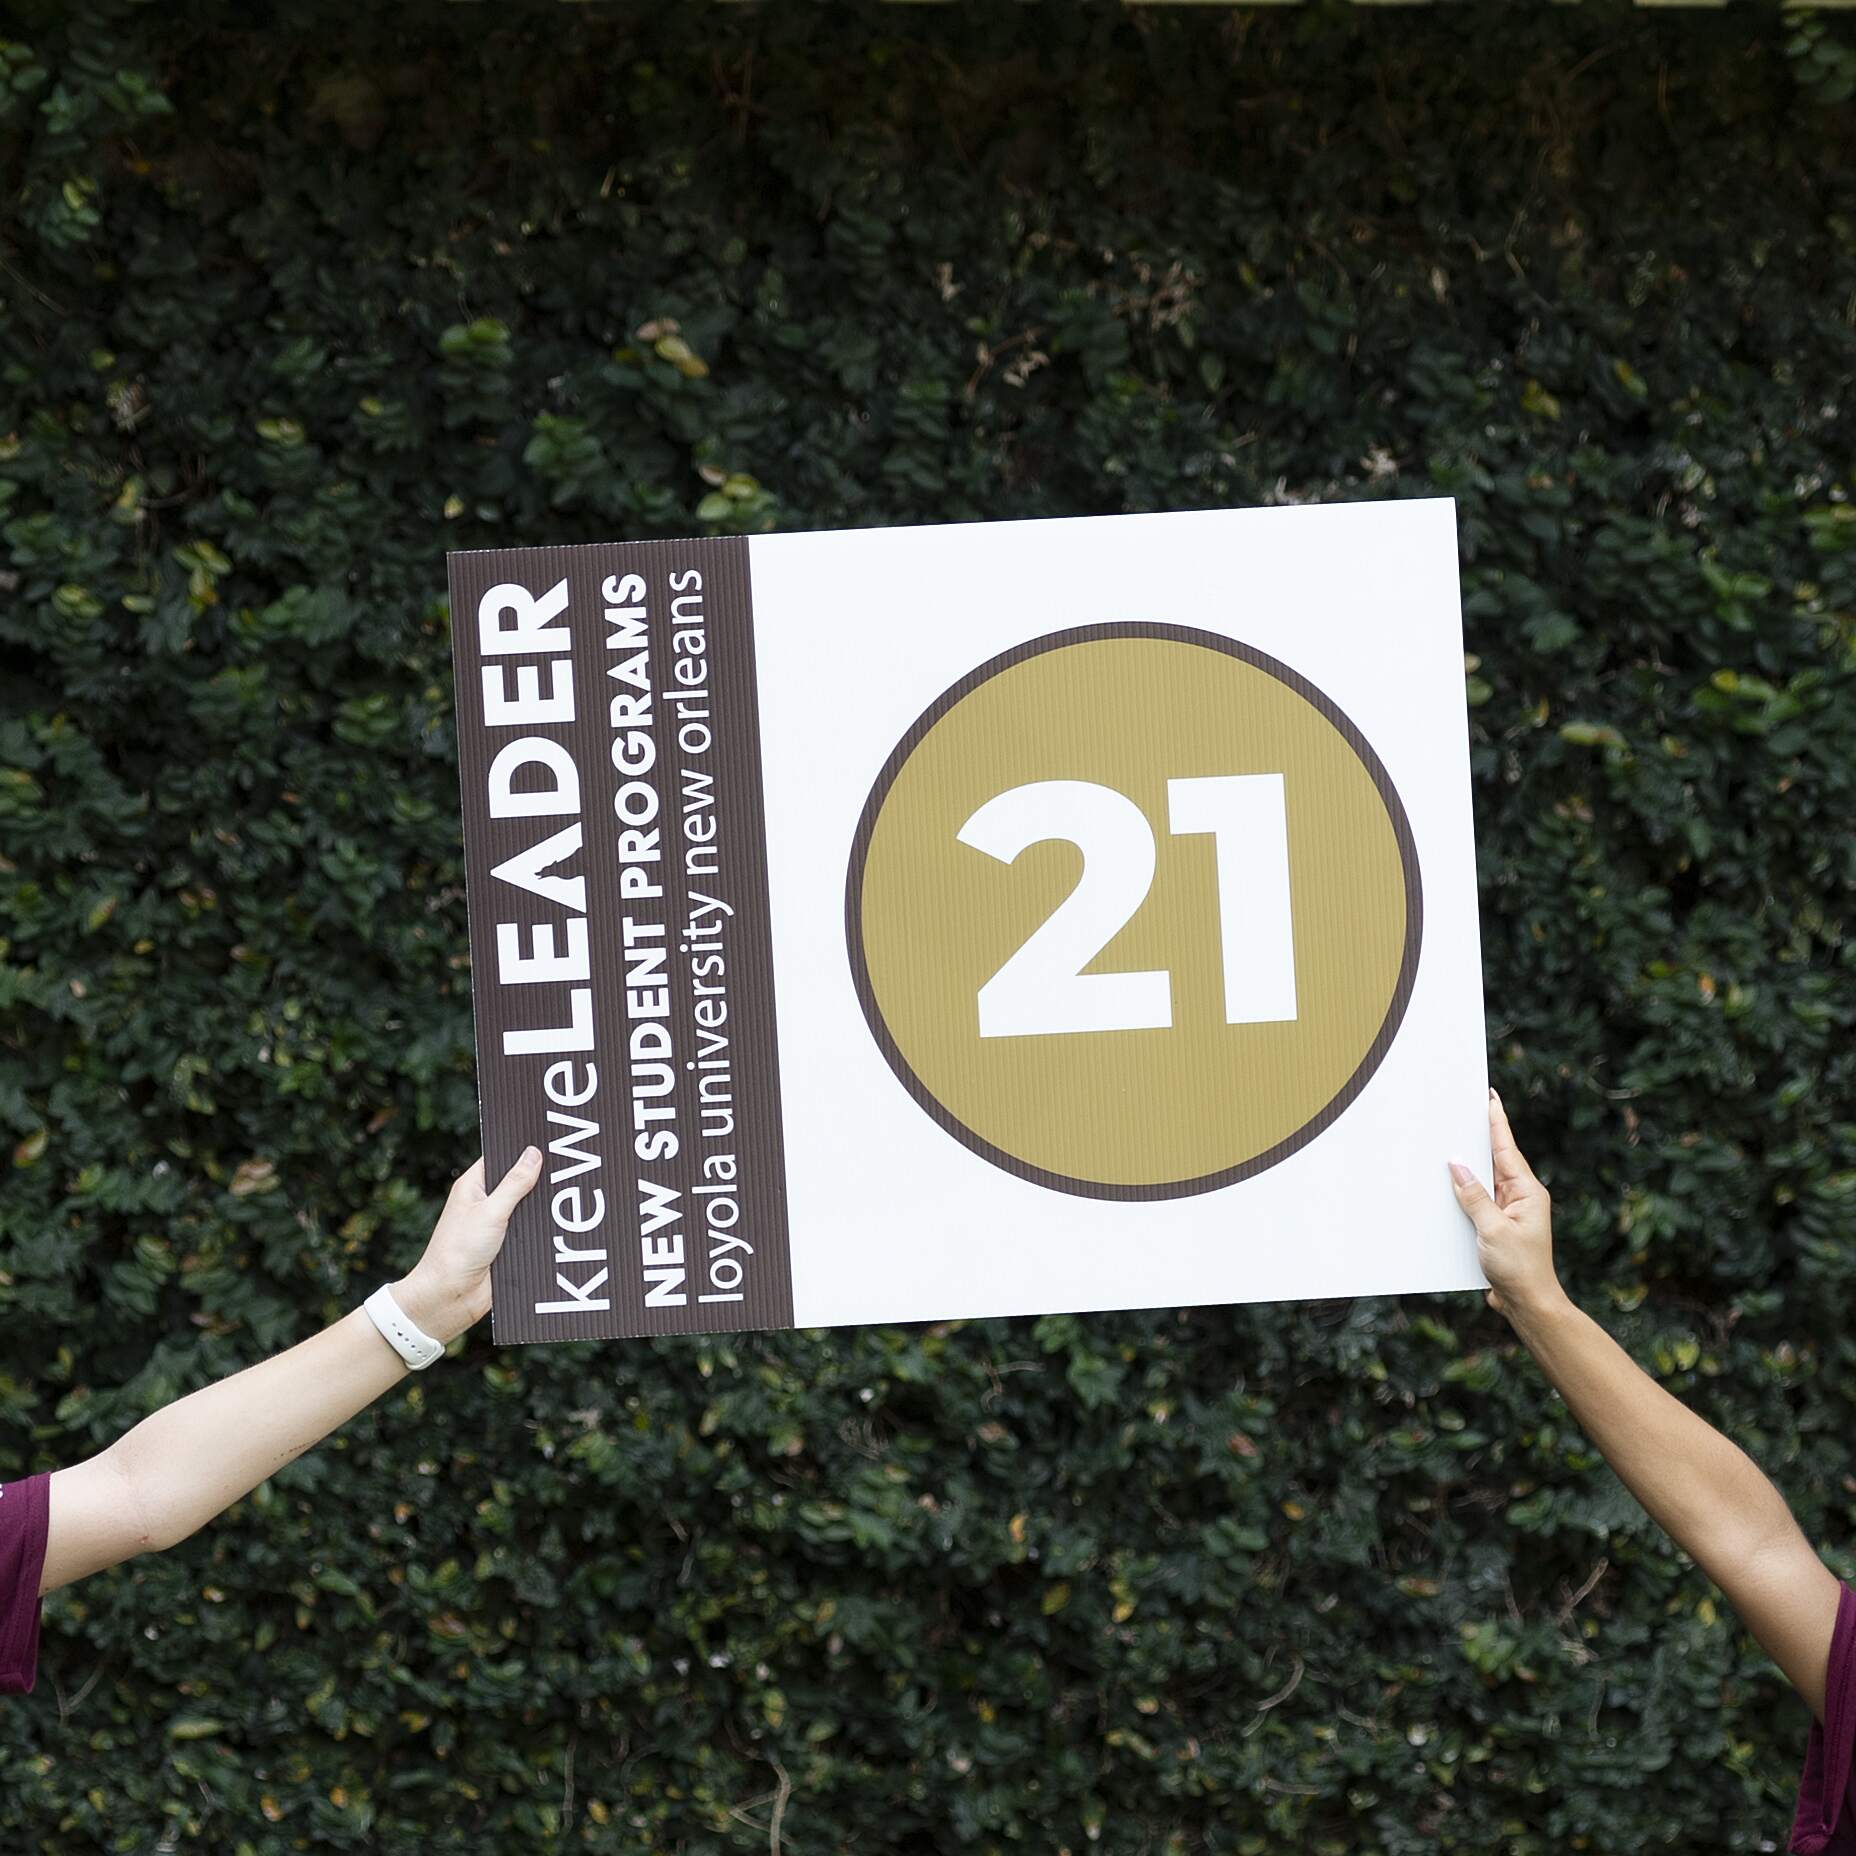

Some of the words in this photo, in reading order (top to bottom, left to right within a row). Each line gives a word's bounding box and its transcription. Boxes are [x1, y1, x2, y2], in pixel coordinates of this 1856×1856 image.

[601, 572, 663, 900] PROGRAMS
[662, 569, 712, 755] orleans
[680, 768, 719, 876] new
[955, 772, 1298, 1038] 21
[478, 577, 610, 1314] kreweLEADER
[622, 916, 680, 1162] STUDENT
[679, 890, 735, 1138] university
[637, 1178, 687, 1308] NEW
[691, 1153, 754, 1304] loyola
